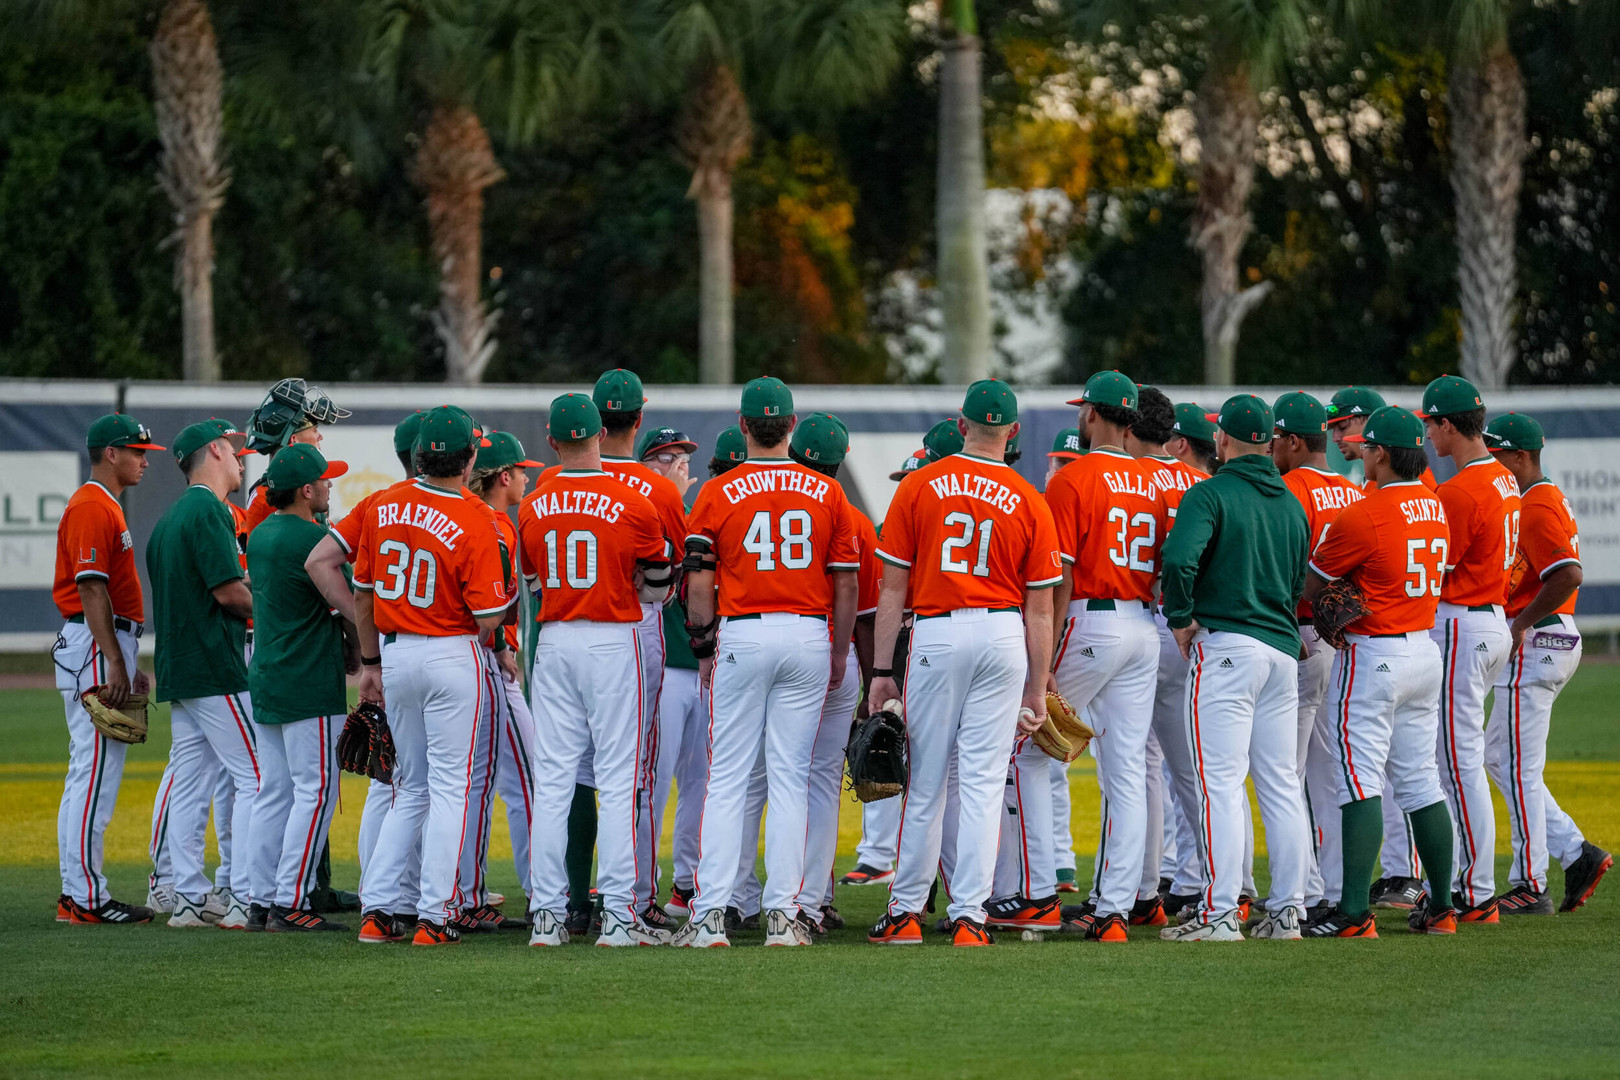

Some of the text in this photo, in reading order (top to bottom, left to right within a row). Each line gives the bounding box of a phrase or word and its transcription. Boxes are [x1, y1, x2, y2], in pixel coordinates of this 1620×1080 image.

[531, 490, 625, 524] WALTERS
[722, 469, 829, 504] CROWTHER
[928, 473, 1021, 515] WALTERS
[1103, 471, 1156, 501] GALLO
[1399, 499, 1446, 525] SCINTA
[377, 502, 464, 551] BRAENDEL
[742, 509, 813, 572] 48
[940, 511, 994, 578] 21
[1107, 506, 1157, 573] 32
[374, 538, 437, 609] 30
[544, 529, 598, 590] 10
[1404, 537, 1448, 598] 53
